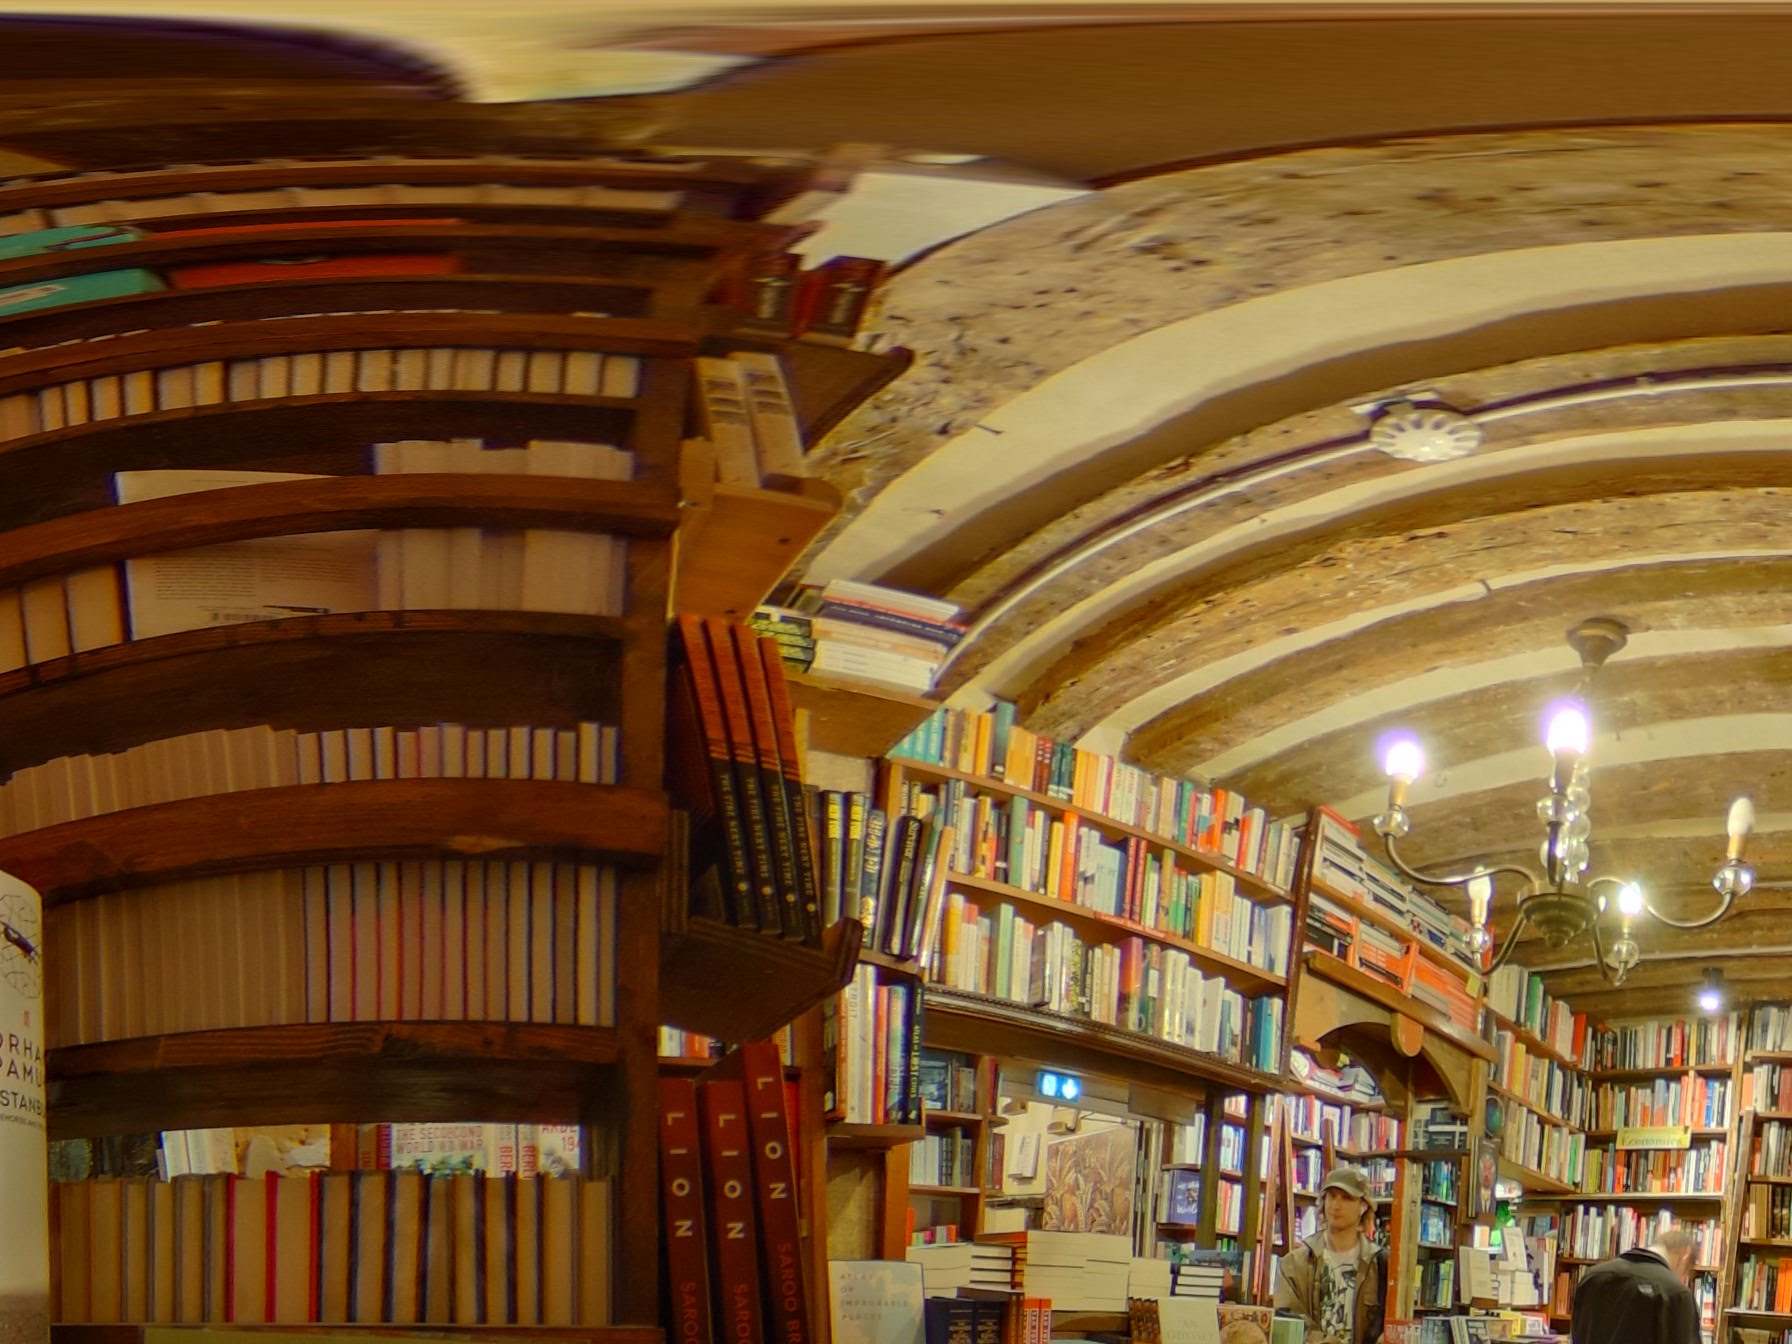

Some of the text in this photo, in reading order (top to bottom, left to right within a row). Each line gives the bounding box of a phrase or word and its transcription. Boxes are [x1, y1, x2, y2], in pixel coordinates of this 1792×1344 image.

[667, 1110, 694, 1237] LION
[717, 1112, 746, 1240] LION
[757, 1076, 787, 1200] LION
